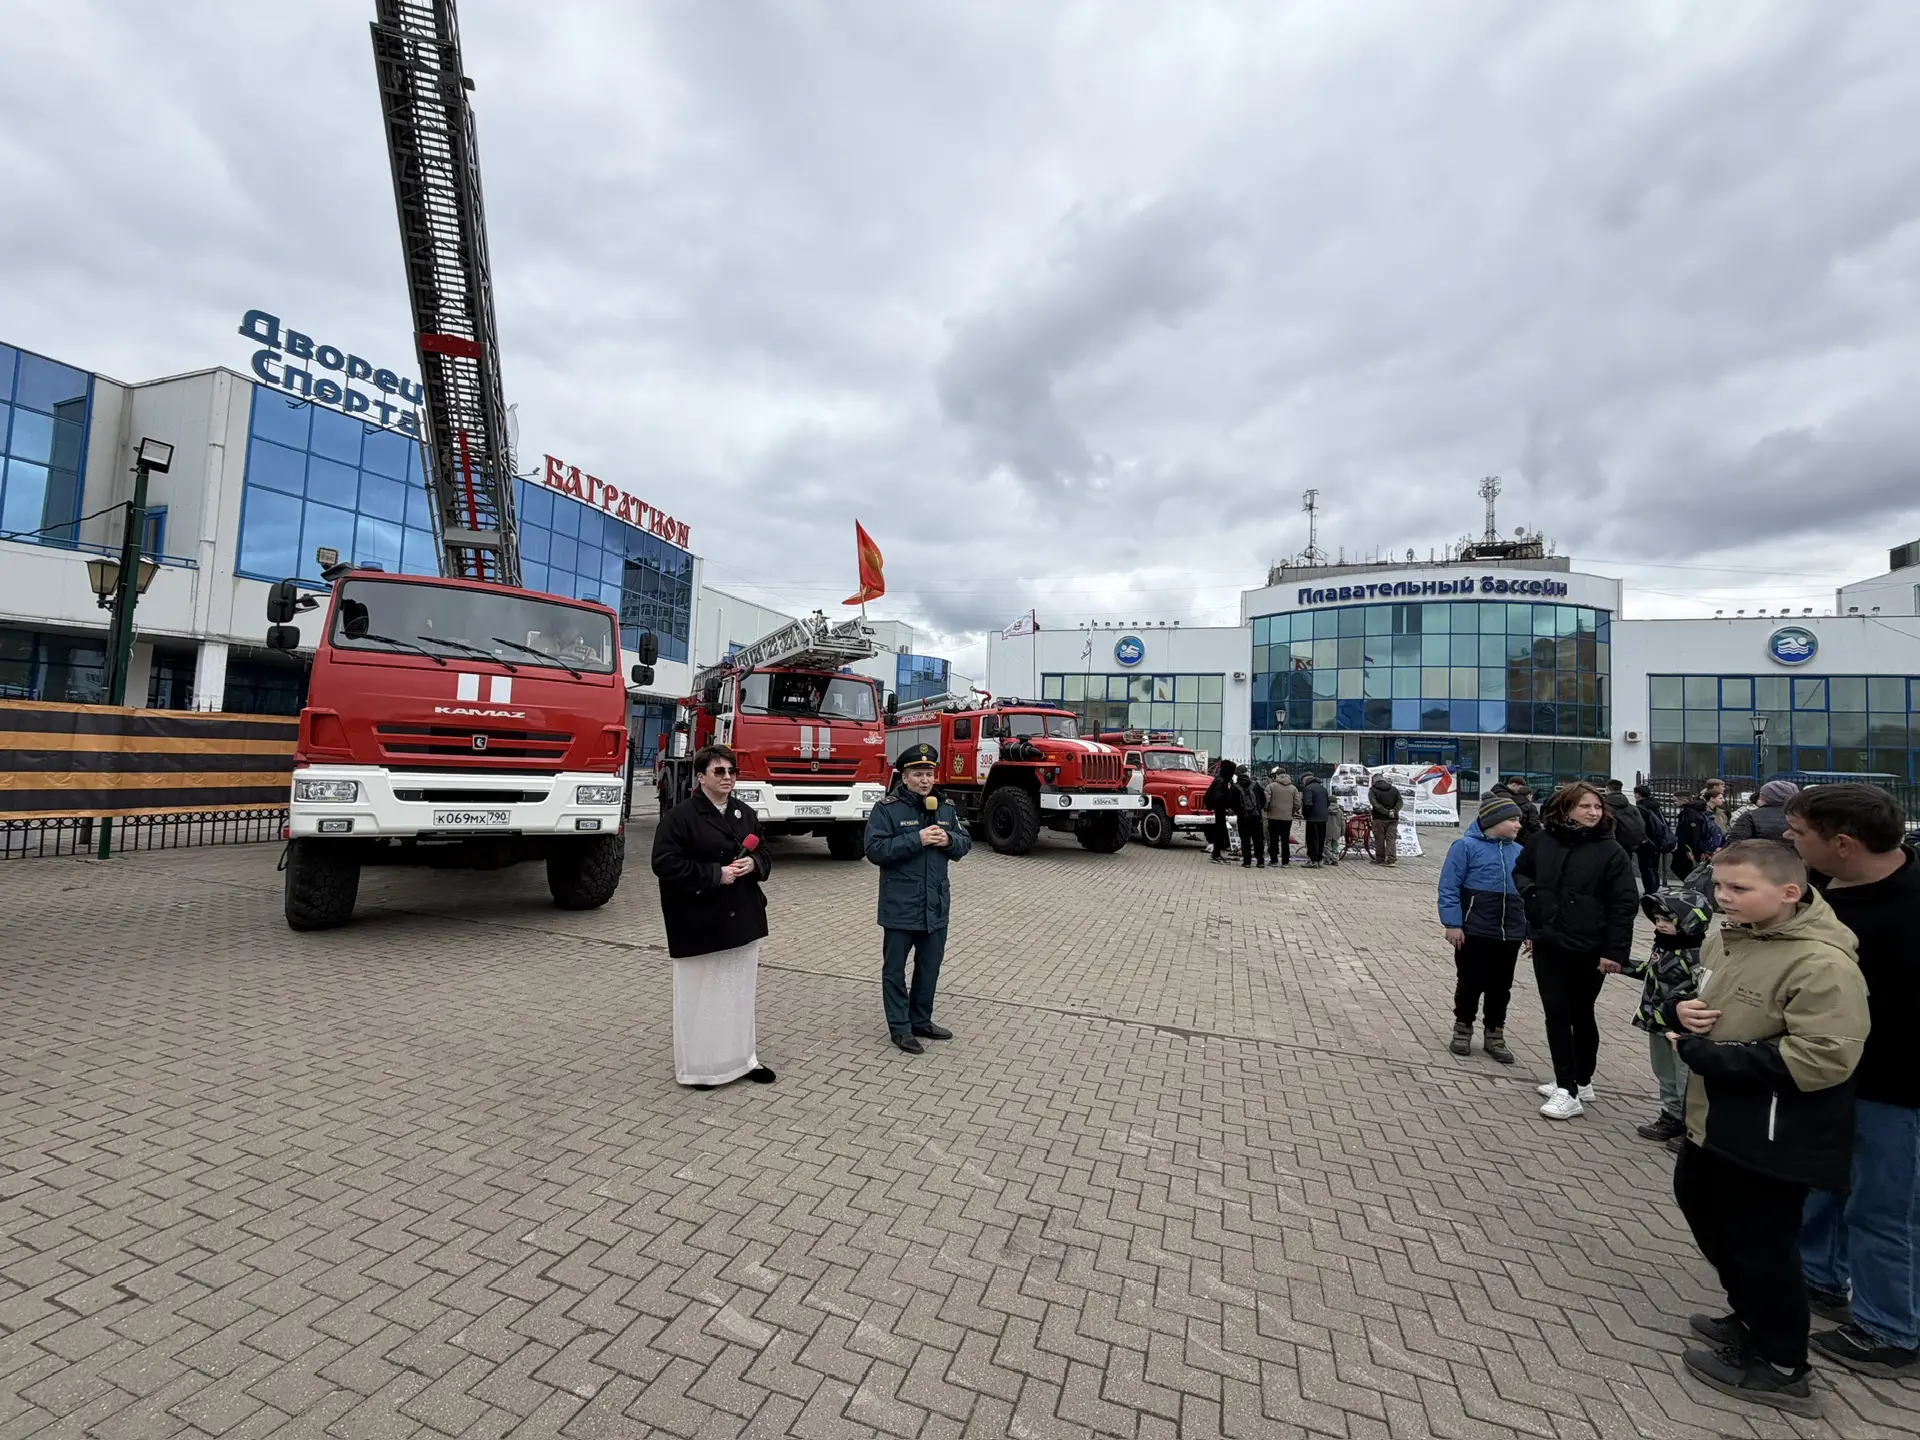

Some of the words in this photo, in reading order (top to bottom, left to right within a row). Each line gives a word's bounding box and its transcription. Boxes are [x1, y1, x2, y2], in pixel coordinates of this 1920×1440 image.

[238, 309, 423, 405] Дворец
[251, 349, 421, 435] Спорта
[543, 454, 691, 549] БАГРАТИОН
[1298, 576, 1474, 605] Плавательный
[1480, 576, 1567, 596] бассейн
[434, 706, 525, 719] KAMAZ
[980, 754, 993, 764] 308
[488, 812, 507, 821] 790
